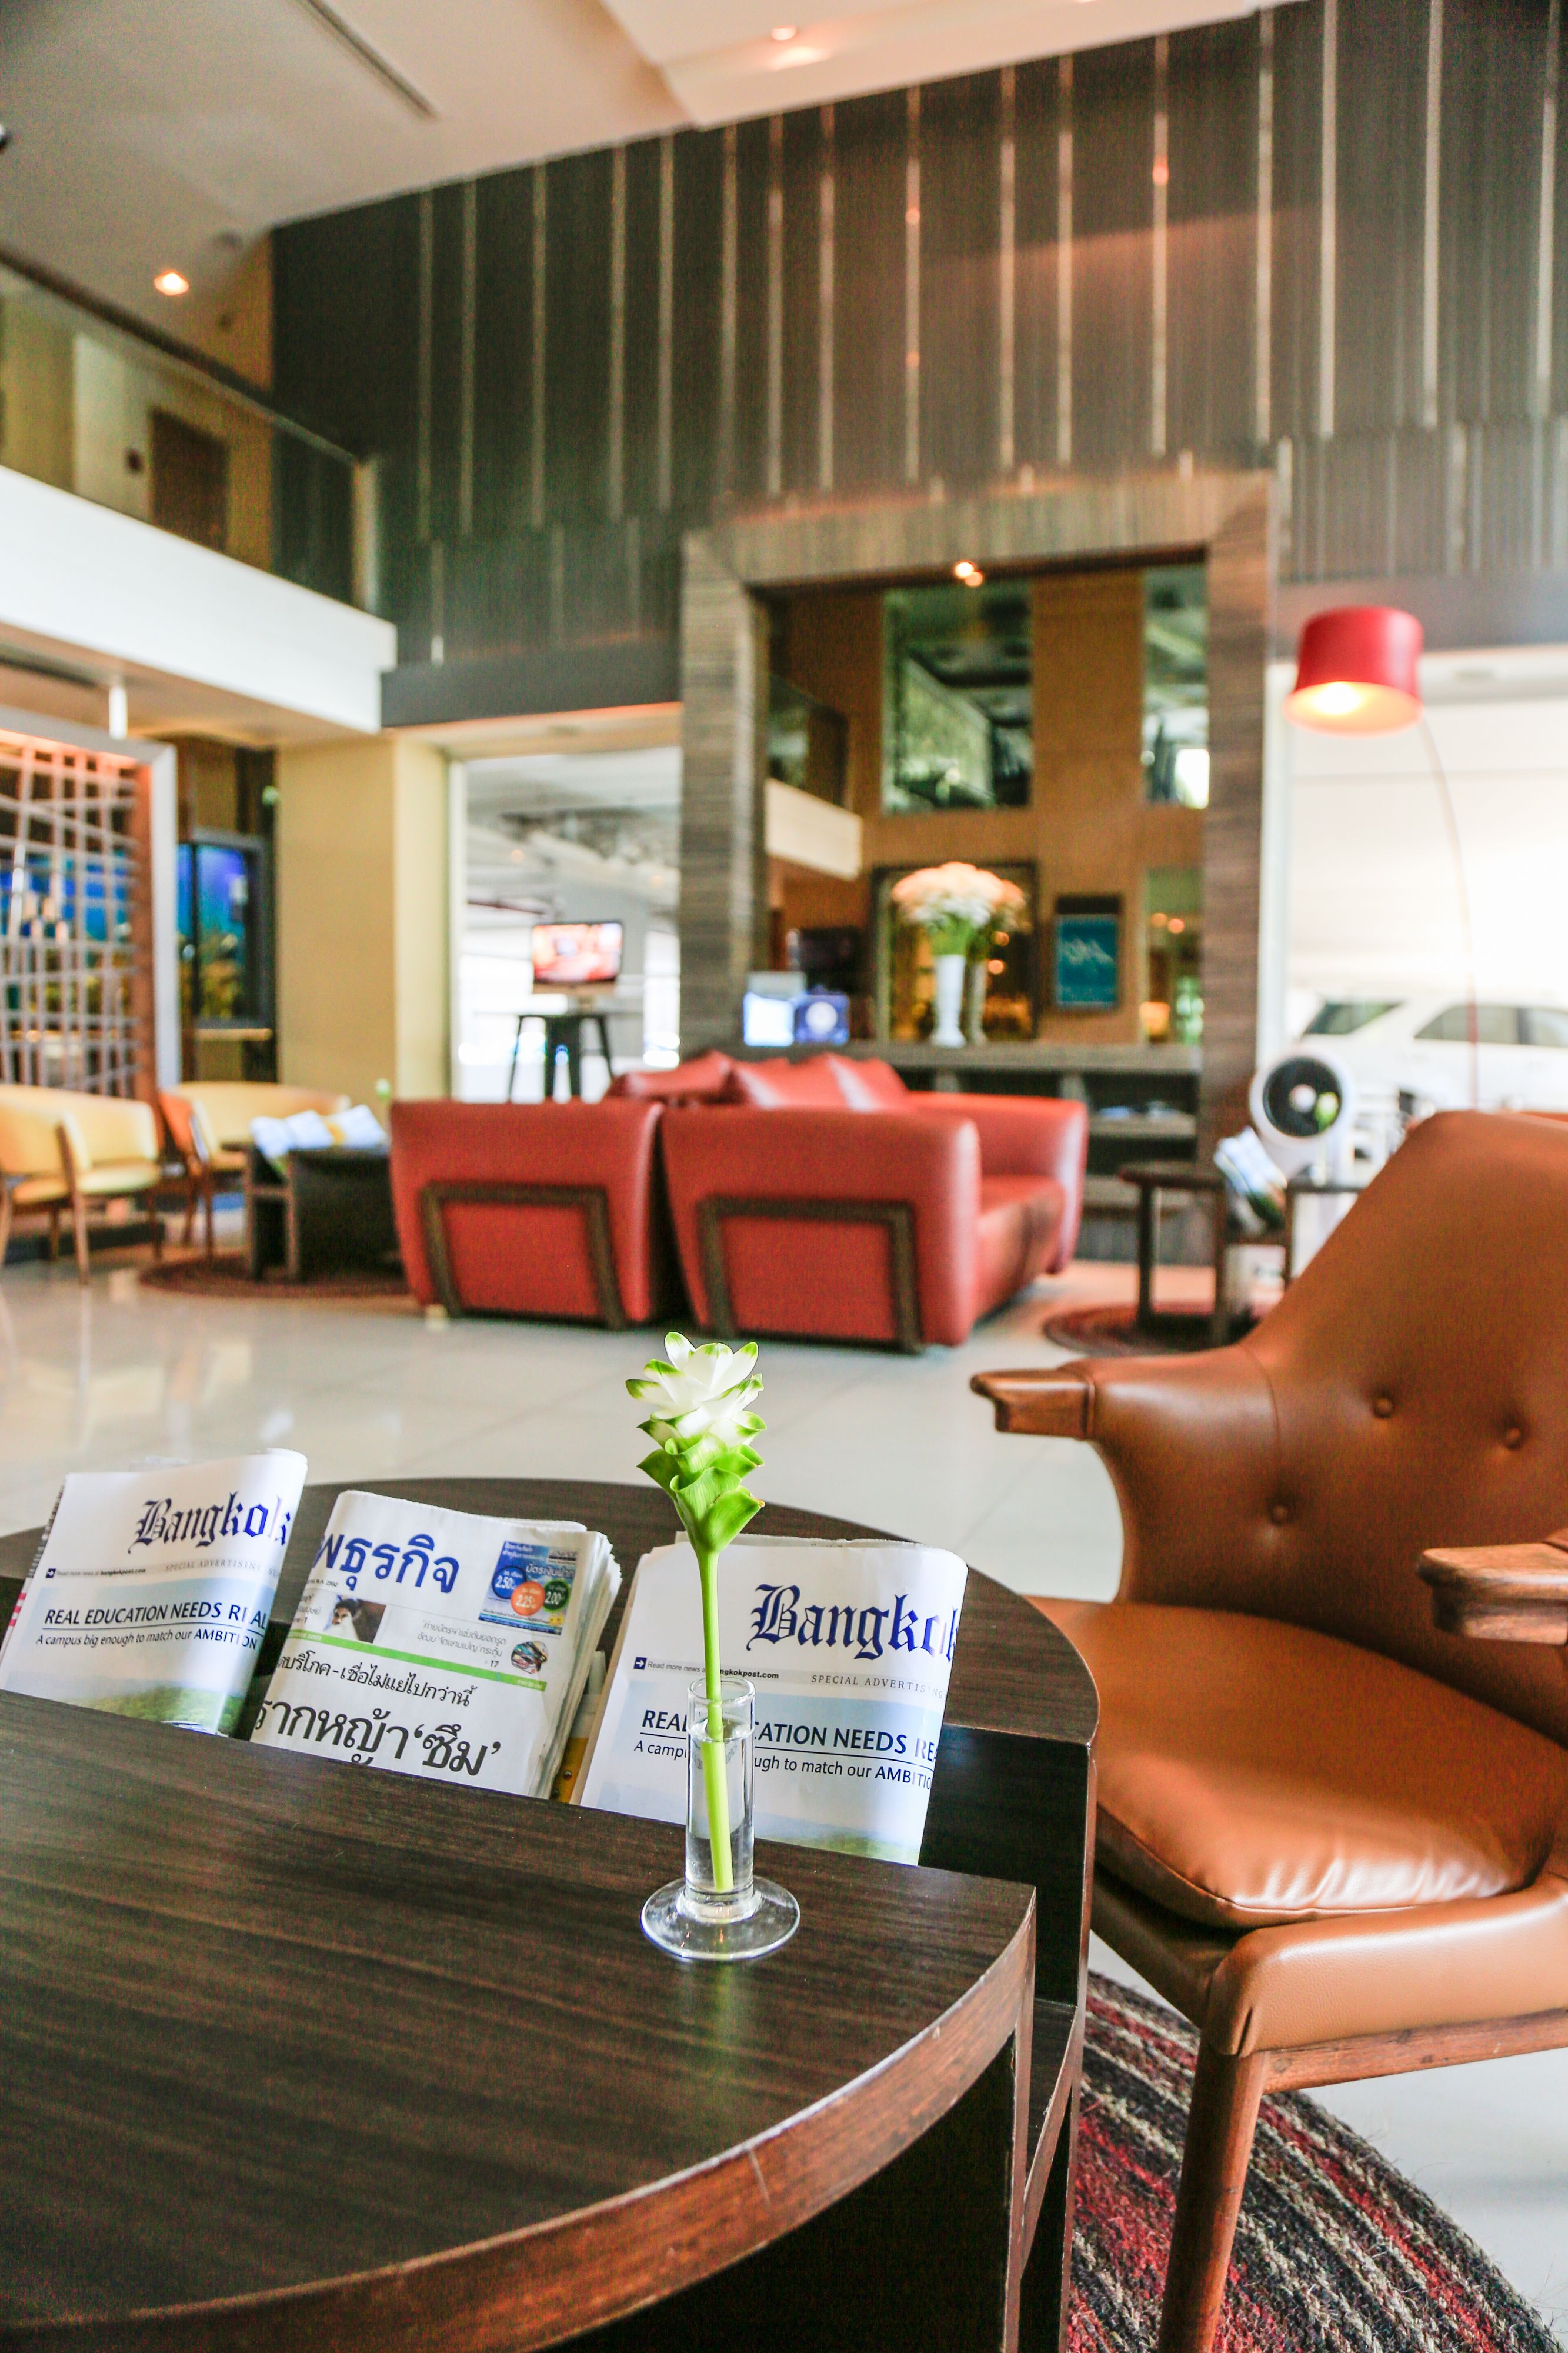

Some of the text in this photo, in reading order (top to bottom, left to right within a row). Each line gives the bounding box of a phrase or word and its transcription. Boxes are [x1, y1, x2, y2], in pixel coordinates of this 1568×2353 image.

[128, 1491, 291, 1554] Bangkok
[44, 1609, 79, 1624] REAL
[84, 1604, 168, 1624] EDUCATION
[170, 1602, 222, 1619] NEEDS
[36, 1634, 43, 1645] A
[45, 1635, 81, 1647] campus
[84, 1634, 98, 1648] big
[100, 1632, 134, 1647] enough
[136, 1634, 145, 1642] to
[146, 1629, 173, 1642] match
[175, 1630, 192, 1640] our
[489, 1659, 499, 1668] 17
[648, 1660, 665, 1669] Read
[720, 1668, 779, 1679] ngkokpost.com
[812, 1674, 943, 1699] SPECIAL ADVERTISNG
[833, 1727, 908, 1754] NEEDS
[634, 1740, 643, 1752] A
[648, 1742, 687, 1761] camp
[785, 1758, 798, 1771] to
[802, 1761, 843, 1775] match
[847, 1765, 872, 1778] our
